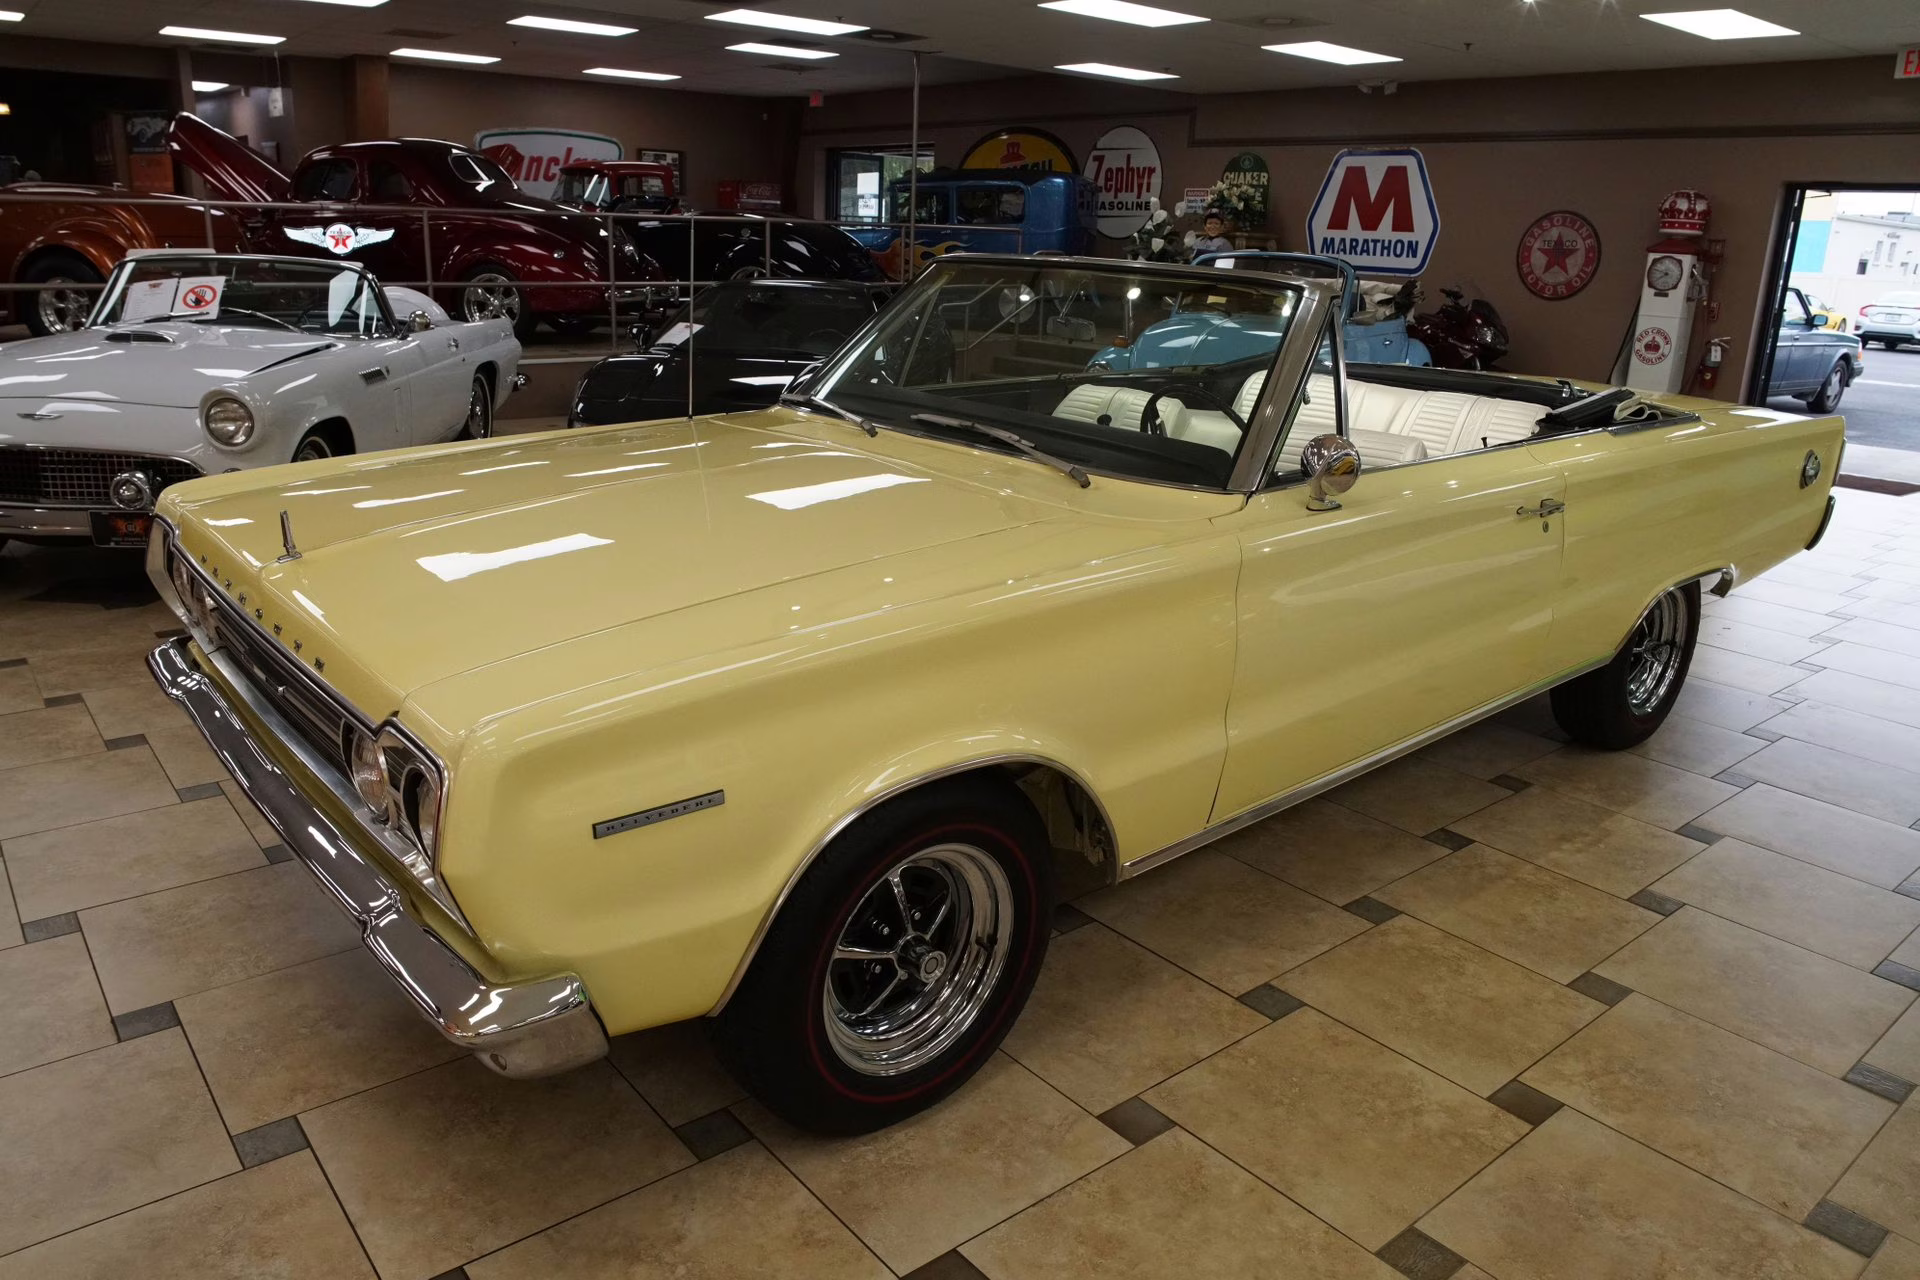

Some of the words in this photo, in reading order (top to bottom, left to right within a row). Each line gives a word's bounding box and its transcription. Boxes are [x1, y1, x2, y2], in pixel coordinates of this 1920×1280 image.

[1092, 153, 1156, 199] Zephyr
[1223, 171, 1269, 187] QUAKER
[1327, 165, 1415, 233] M
[1525, 216, 1594, 249] GASOLINE
[1320, 236, 1419, 259] MARATHON
[1521, 261, 1568, 296] MOTOR
[1571, 265, 1593, 287] OIL
[1636, 330, 1650, 343] RED
[1651, 328, 1671, 345] CROWN
[1635, 349, 1666, 363] GASOLINE
